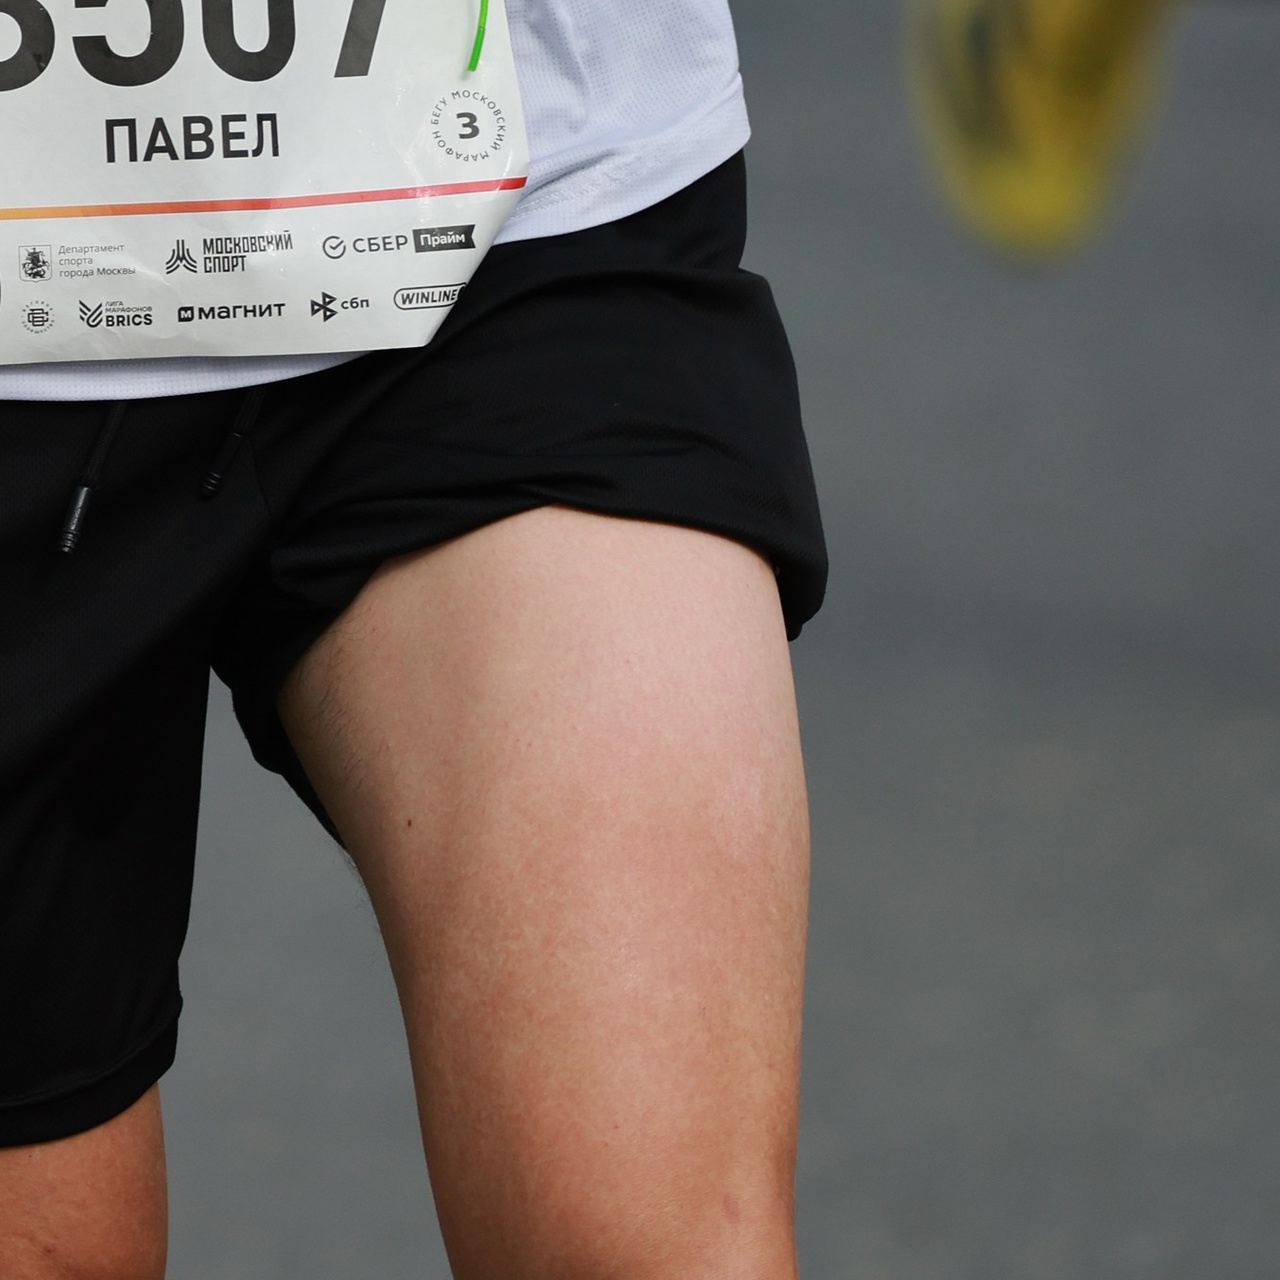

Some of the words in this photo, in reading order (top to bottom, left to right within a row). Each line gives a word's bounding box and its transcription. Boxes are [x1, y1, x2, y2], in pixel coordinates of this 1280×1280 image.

[431, 97, 447, 125] БЕГУ
[451, 89, 506, 151] МОСКОВСКИЙ
[456, 112, 480, 140] 3
[105, 113, 280, 163] ПАВЕЛ
[432, 130, 490, 162] МАРАФОН
[58, 244, 125, 256] Департамент
[202, 230, 294, 255] МОСКОВСКИЙ
[353, 235, 408, 253] СБЕР
[420, 231, 466, 248] Прайм
[59, 257, 94, 268] спорта
[203, 255, 247, 274] СПОРТ
[59, 269, 95, 280] города
[97, 267, 137, 276] Москвы
[340, 297, 370, 310] сбп
[401, 289, 458, 305] WINLINE
[105, 313, 153, 327] BRICS
[198, 303, 286, 321] магнит
